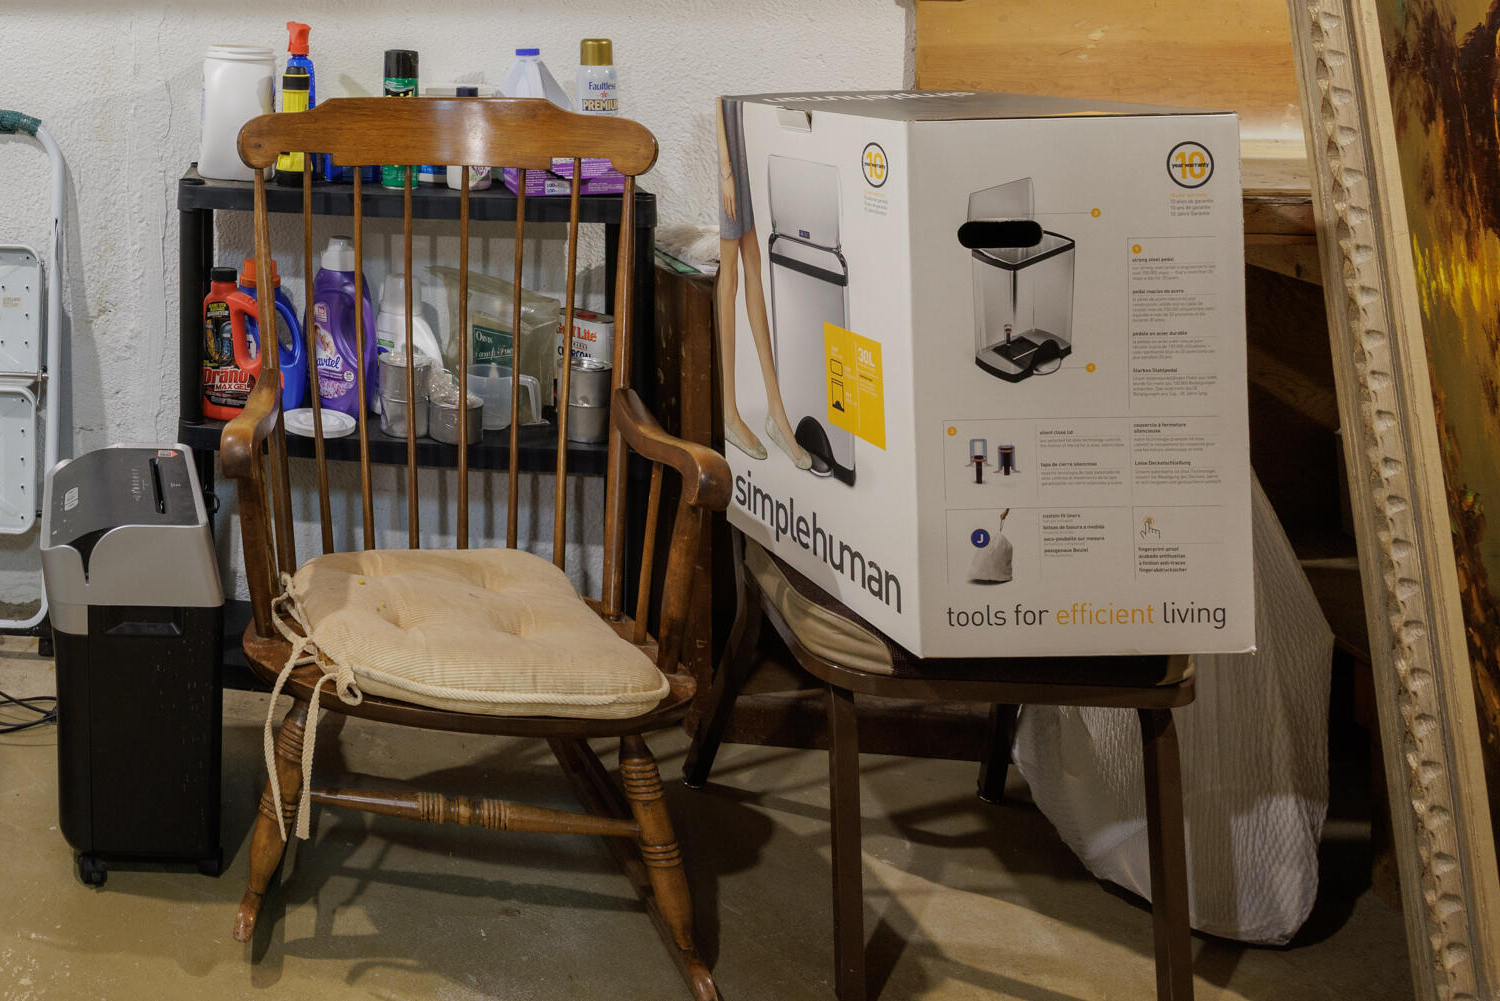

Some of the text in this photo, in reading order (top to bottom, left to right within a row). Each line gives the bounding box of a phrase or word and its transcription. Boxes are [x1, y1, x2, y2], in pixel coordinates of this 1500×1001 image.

[1175, 151, 1207, 179] 10
[214, 383, 232, 391] MAX
[735, 470, 902, 614] simplehuman
[947, 601, 1226, 630] tools for efficient living
